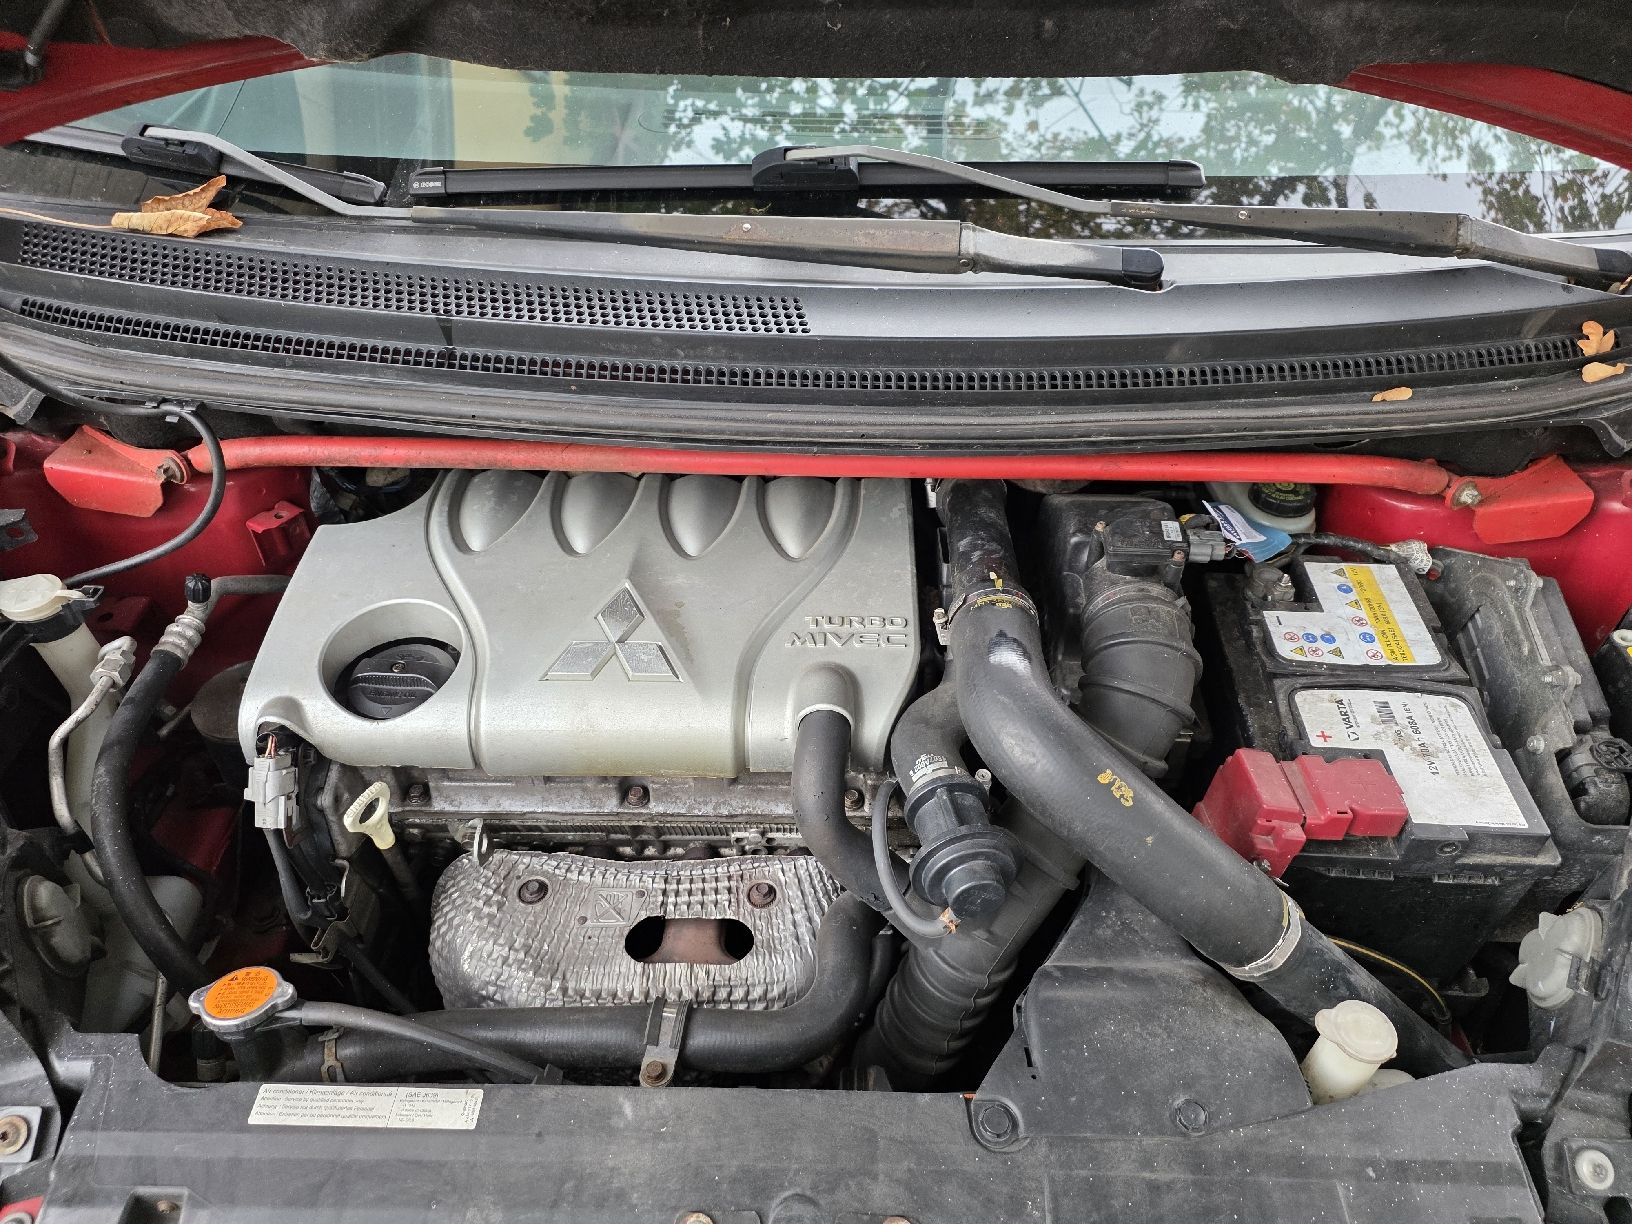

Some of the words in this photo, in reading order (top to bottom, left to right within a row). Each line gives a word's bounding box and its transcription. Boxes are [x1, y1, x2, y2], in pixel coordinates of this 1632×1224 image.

[804, 615, 908, 629] TURBO
[784, 631, 907, 648] MIVEC
[1335, 698, 1354, 730] VARTA
